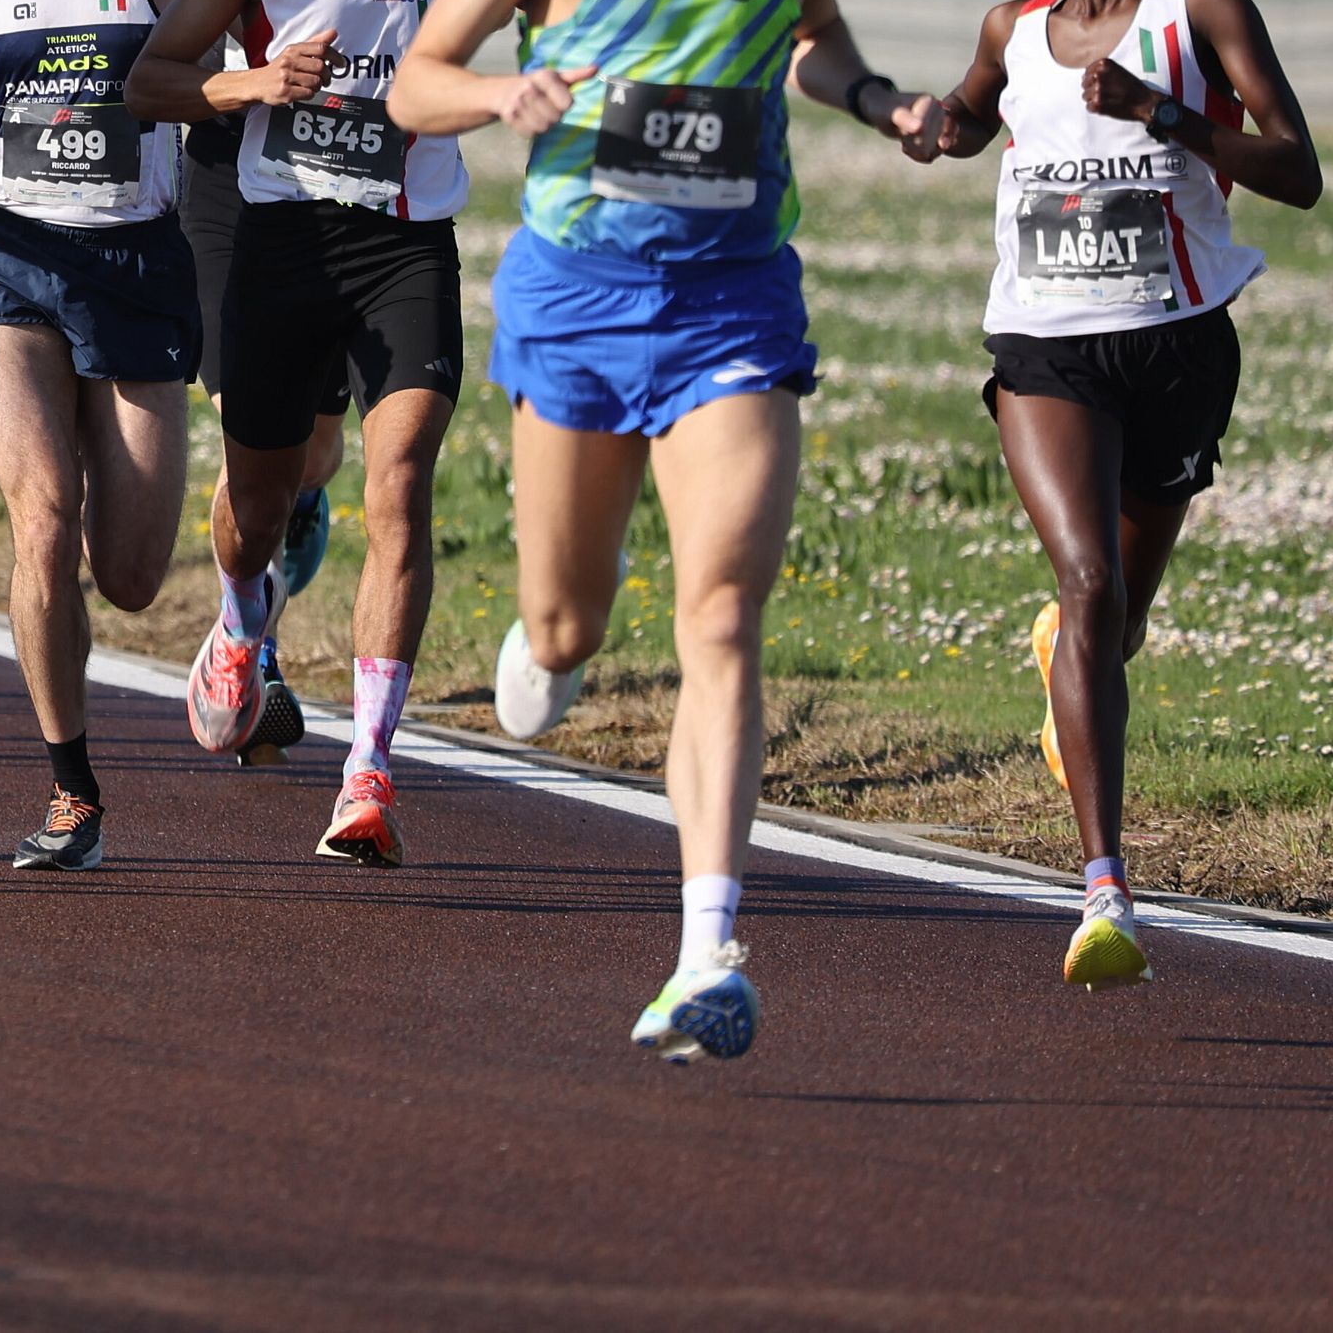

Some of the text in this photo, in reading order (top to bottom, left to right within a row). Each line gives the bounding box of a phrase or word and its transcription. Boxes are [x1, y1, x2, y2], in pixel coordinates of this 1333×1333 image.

[46, 33, 97, 45] TRIATHLON
[47, 44, 97, 55] ATLETICA
[38, 55, 109, 73] MdS
[9, 112, 21, 124] A
[292, 110, 385, 155] 6345
[642, 109, 723, 153] 879
[36, 128, 107, 161] 499
[51, 162, 91, 171] RICCARDO
[1021, 199, 1032, 216] A
[1077, 216, 1093, 231] 10
[1036, 227, 1143, 268] LAGAT
